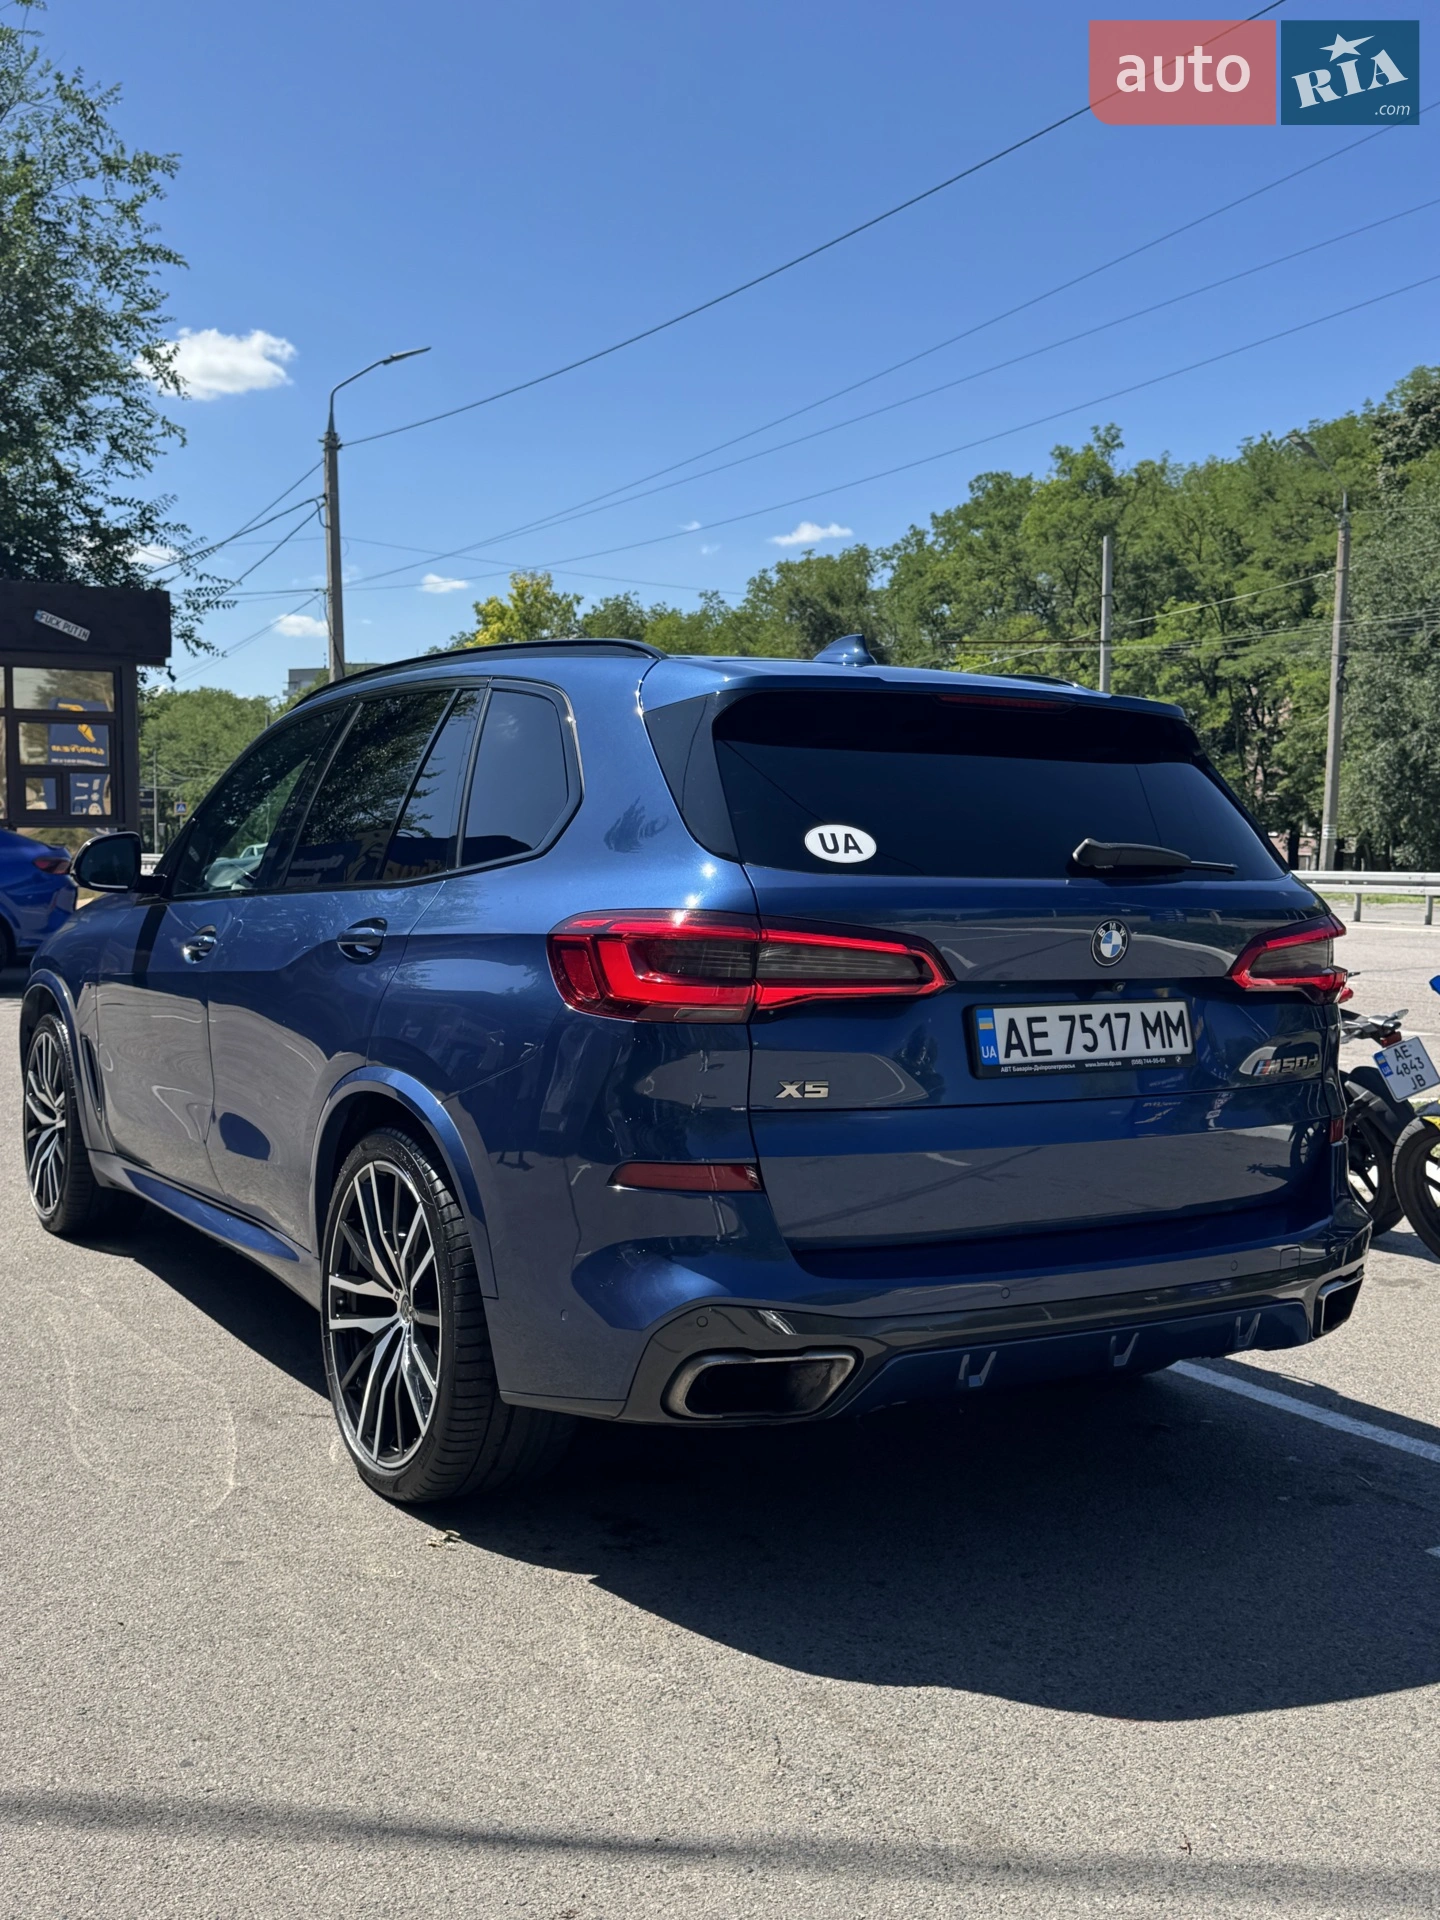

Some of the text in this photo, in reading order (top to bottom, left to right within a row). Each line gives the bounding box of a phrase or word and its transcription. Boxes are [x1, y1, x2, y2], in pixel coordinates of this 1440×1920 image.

[41, 612, 89, 639] FUCK PUTIN
[818, 832, 864, 855] UA
[1097, 922, 1126, 937] BMW
[1004, 1009, 1189, 1059] AE 7517 MM
[981, 1046, 997, 1060] UA
[1394, 1044, 1413, 1062] AE
[1395, 1056, 1426, 1078] 4843
[775, 1079, 829, 1099] X5
[1410, 1073, 1427, 1091] JB
